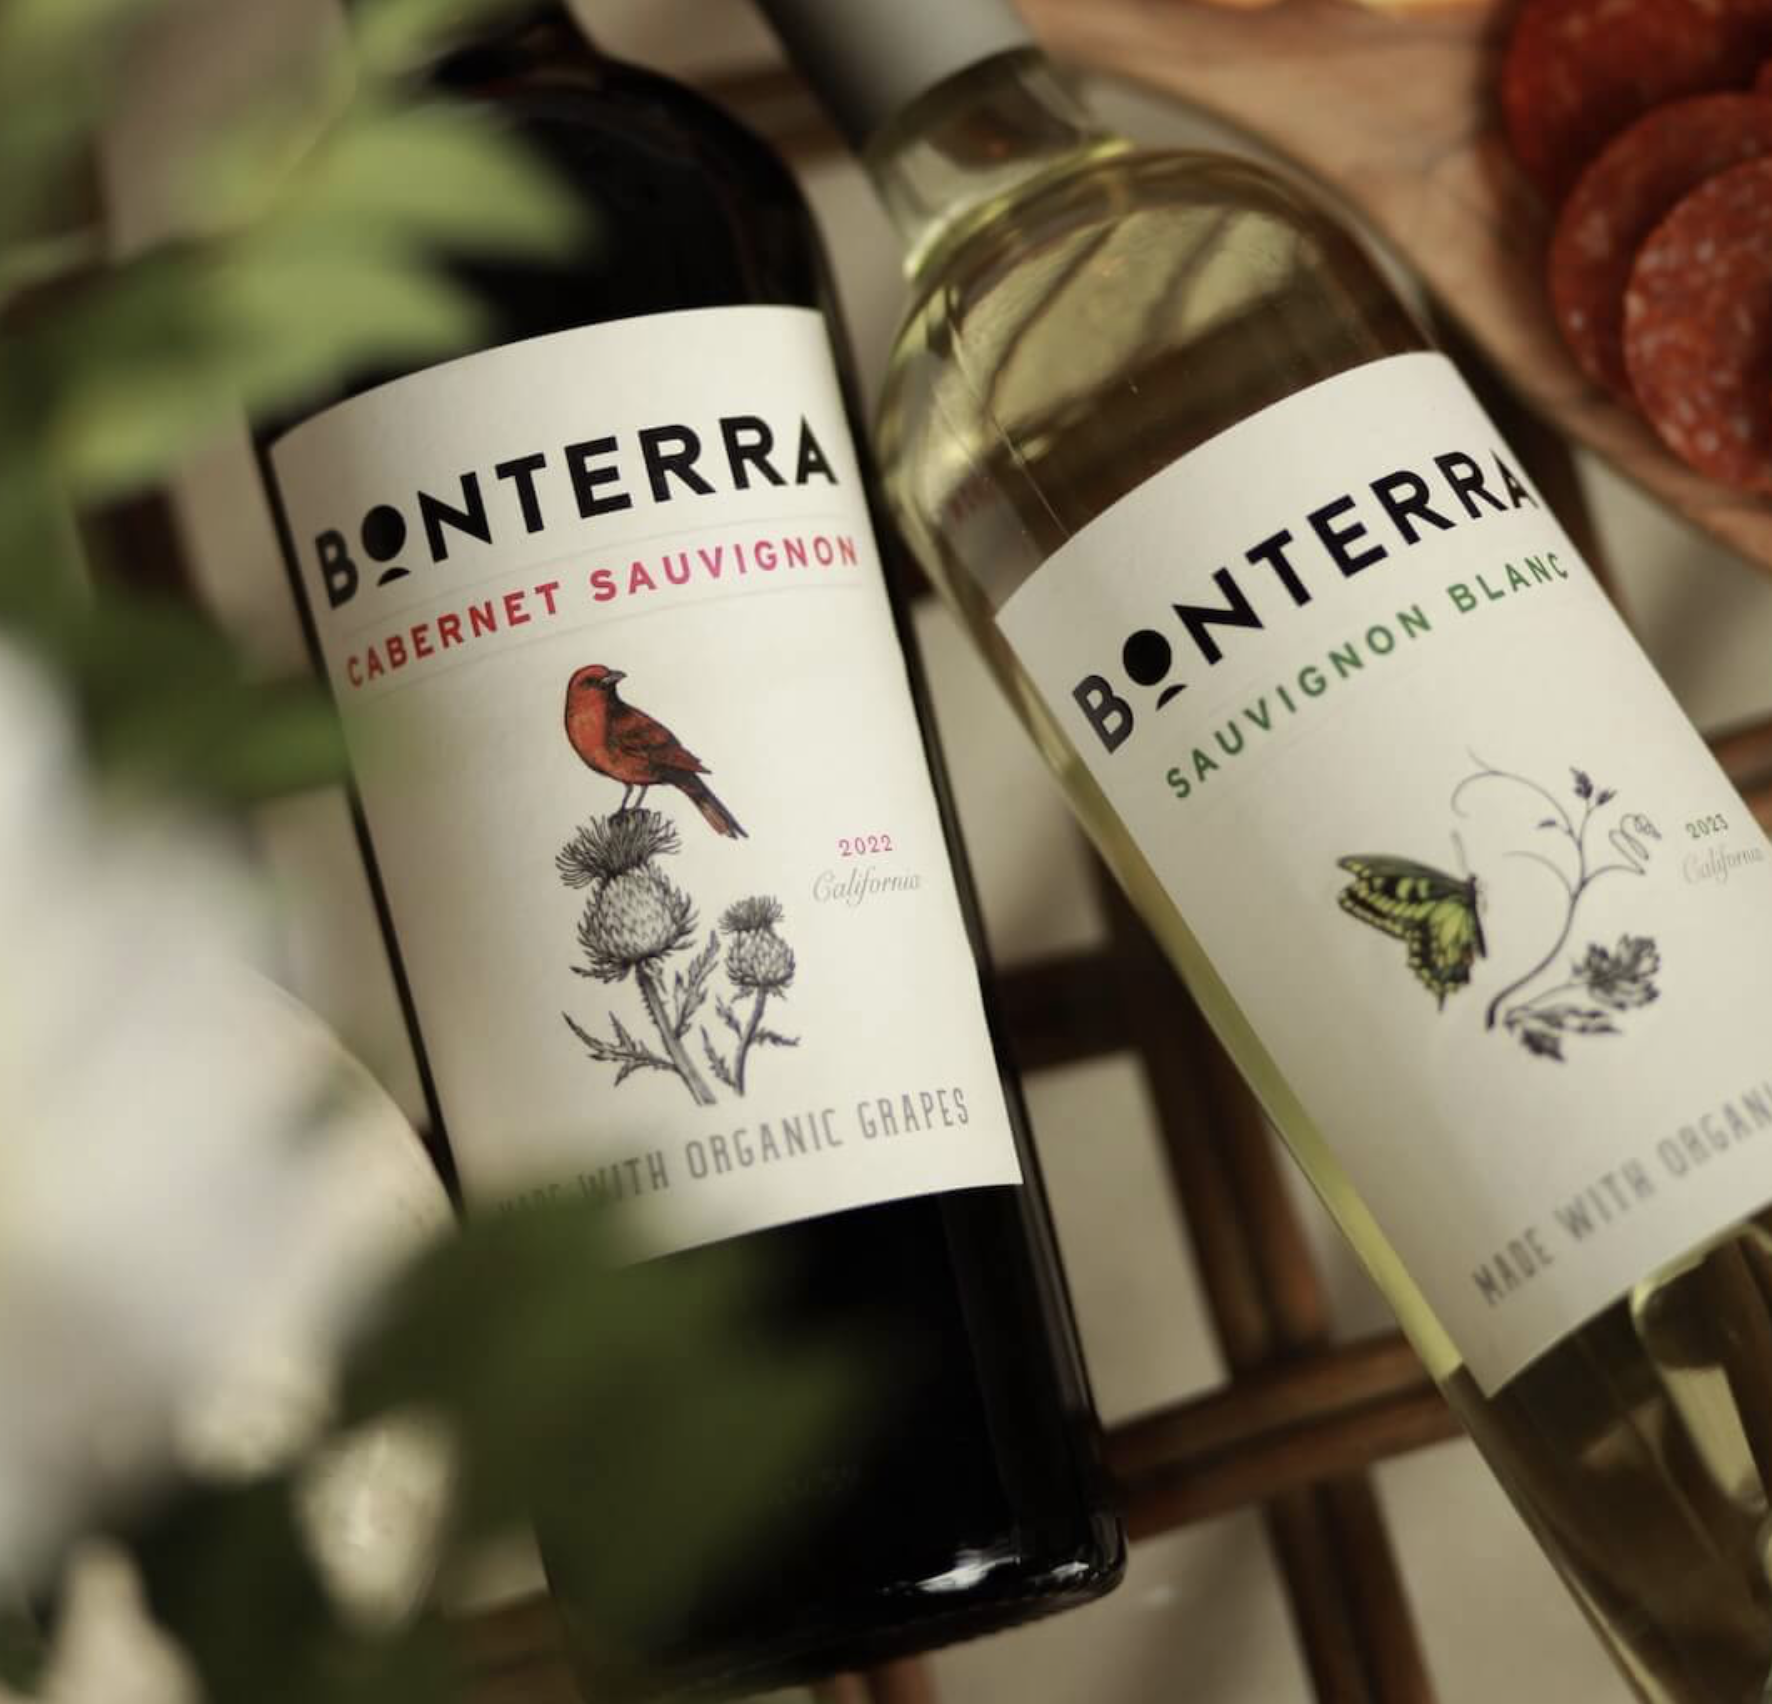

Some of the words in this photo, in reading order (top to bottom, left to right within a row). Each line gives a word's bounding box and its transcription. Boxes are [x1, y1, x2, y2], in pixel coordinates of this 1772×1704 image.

[315, 414, 839, 610] BONTERRA
[347, 581, 561, 689] CABERNET
[588, 536, 859, 602] SAUVIGNON
[1072, 450, 1539, 754] BONTERRA
[1166, 605, 1433, 799] SAUVIGNON
[1447, 551, 1570, 614] BLANC
[812, 865, 921, 906] California
[838, 834, 893, 857] 2022
[576, 1149, 670, 1202] WITH
[684, 1108, 844, 1181] ORGANIC
[857, 1086, 970, 1140] GRAPES
[1473, 1228, 1555, 1307] MADE
[1554, 1158, 1658, 1241] WITH
